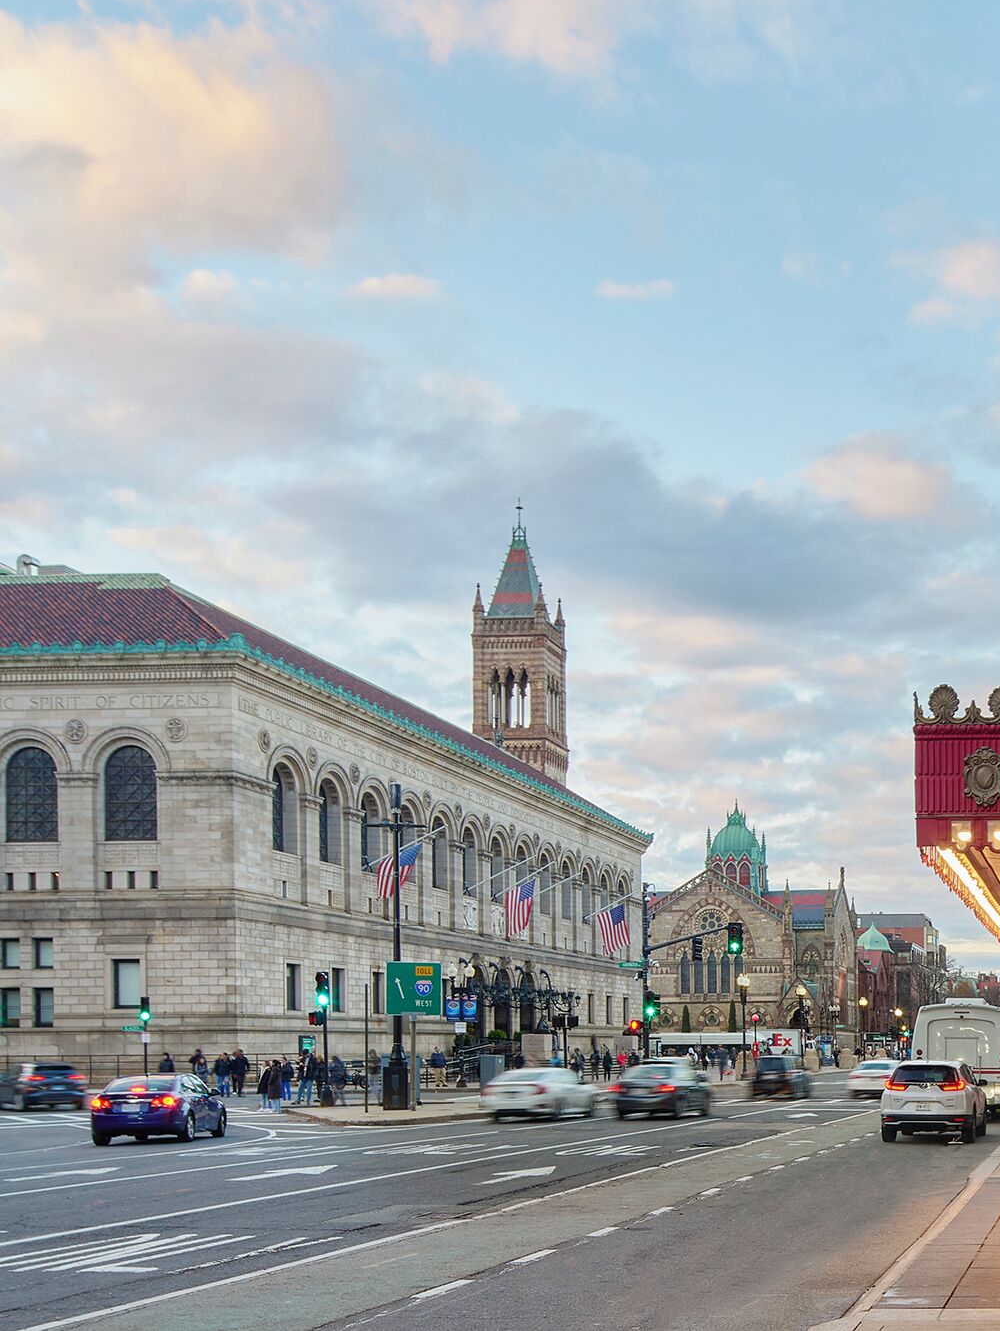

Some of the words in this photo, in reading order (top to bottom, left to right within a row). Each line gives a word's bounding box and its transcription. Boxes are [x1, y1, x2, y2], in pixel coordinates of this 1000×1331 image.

[30, 696, 81, 710] SPIRIT
[95, 695, 117, 709] OF
[129, 694, 210, 709] CITIZENS
[240, 697, 259, 713] THE
[265, 708, 293, 730] PUBLIC
[300, 720, 333, 744] LIBRARY
[338, 737, 348, 749] OF
[352, 743, 366, 757] THE
[369, 749, 387, 765] CITY
[418, 984, 430, 993] 90
[415, 999, 432, 1007] WEST
